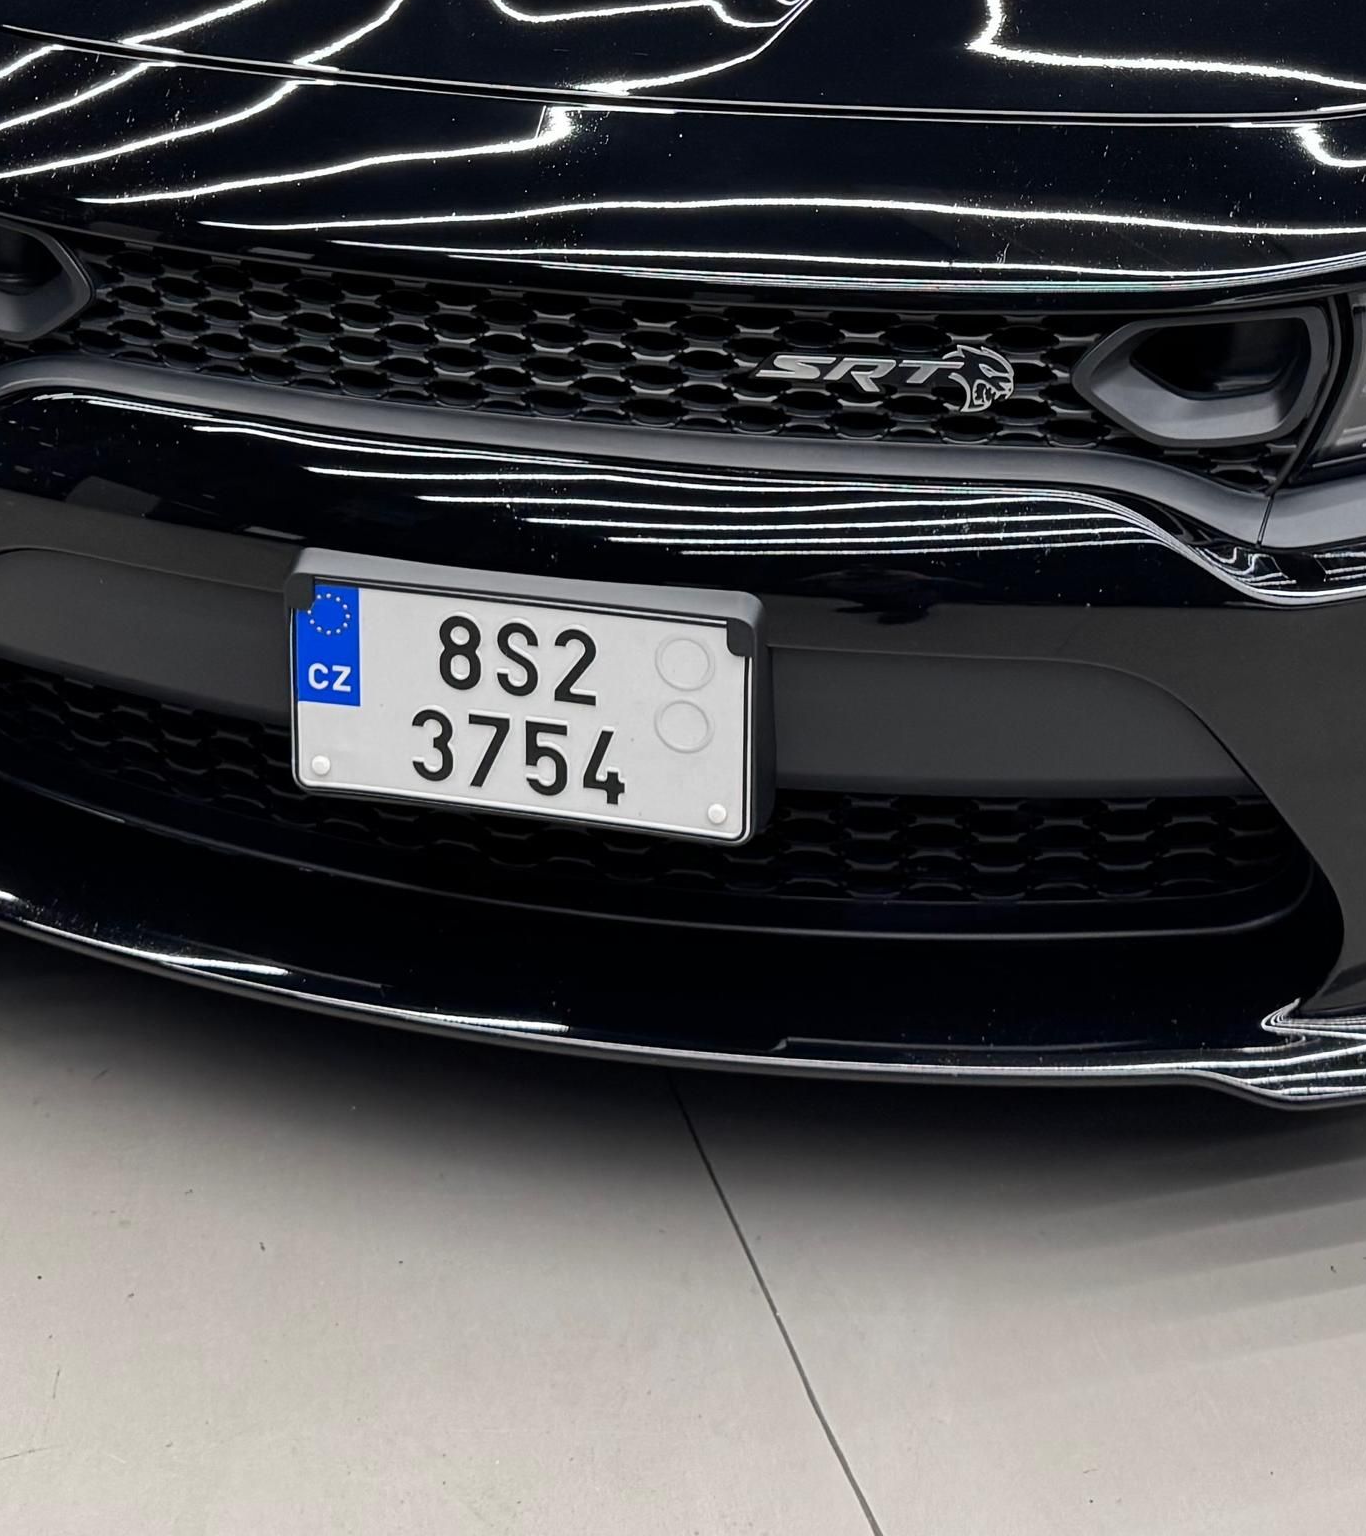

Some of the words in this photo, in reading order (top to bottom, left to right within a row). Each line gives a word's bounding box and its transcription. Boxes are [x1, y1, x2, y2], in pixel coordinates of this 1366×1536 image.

[755, 355, 964, 392] SRT
[308, 663, 351, 692] CZ
[439, 615, 597, 706] 8S2
[411, 709, 625, 805] 3754
